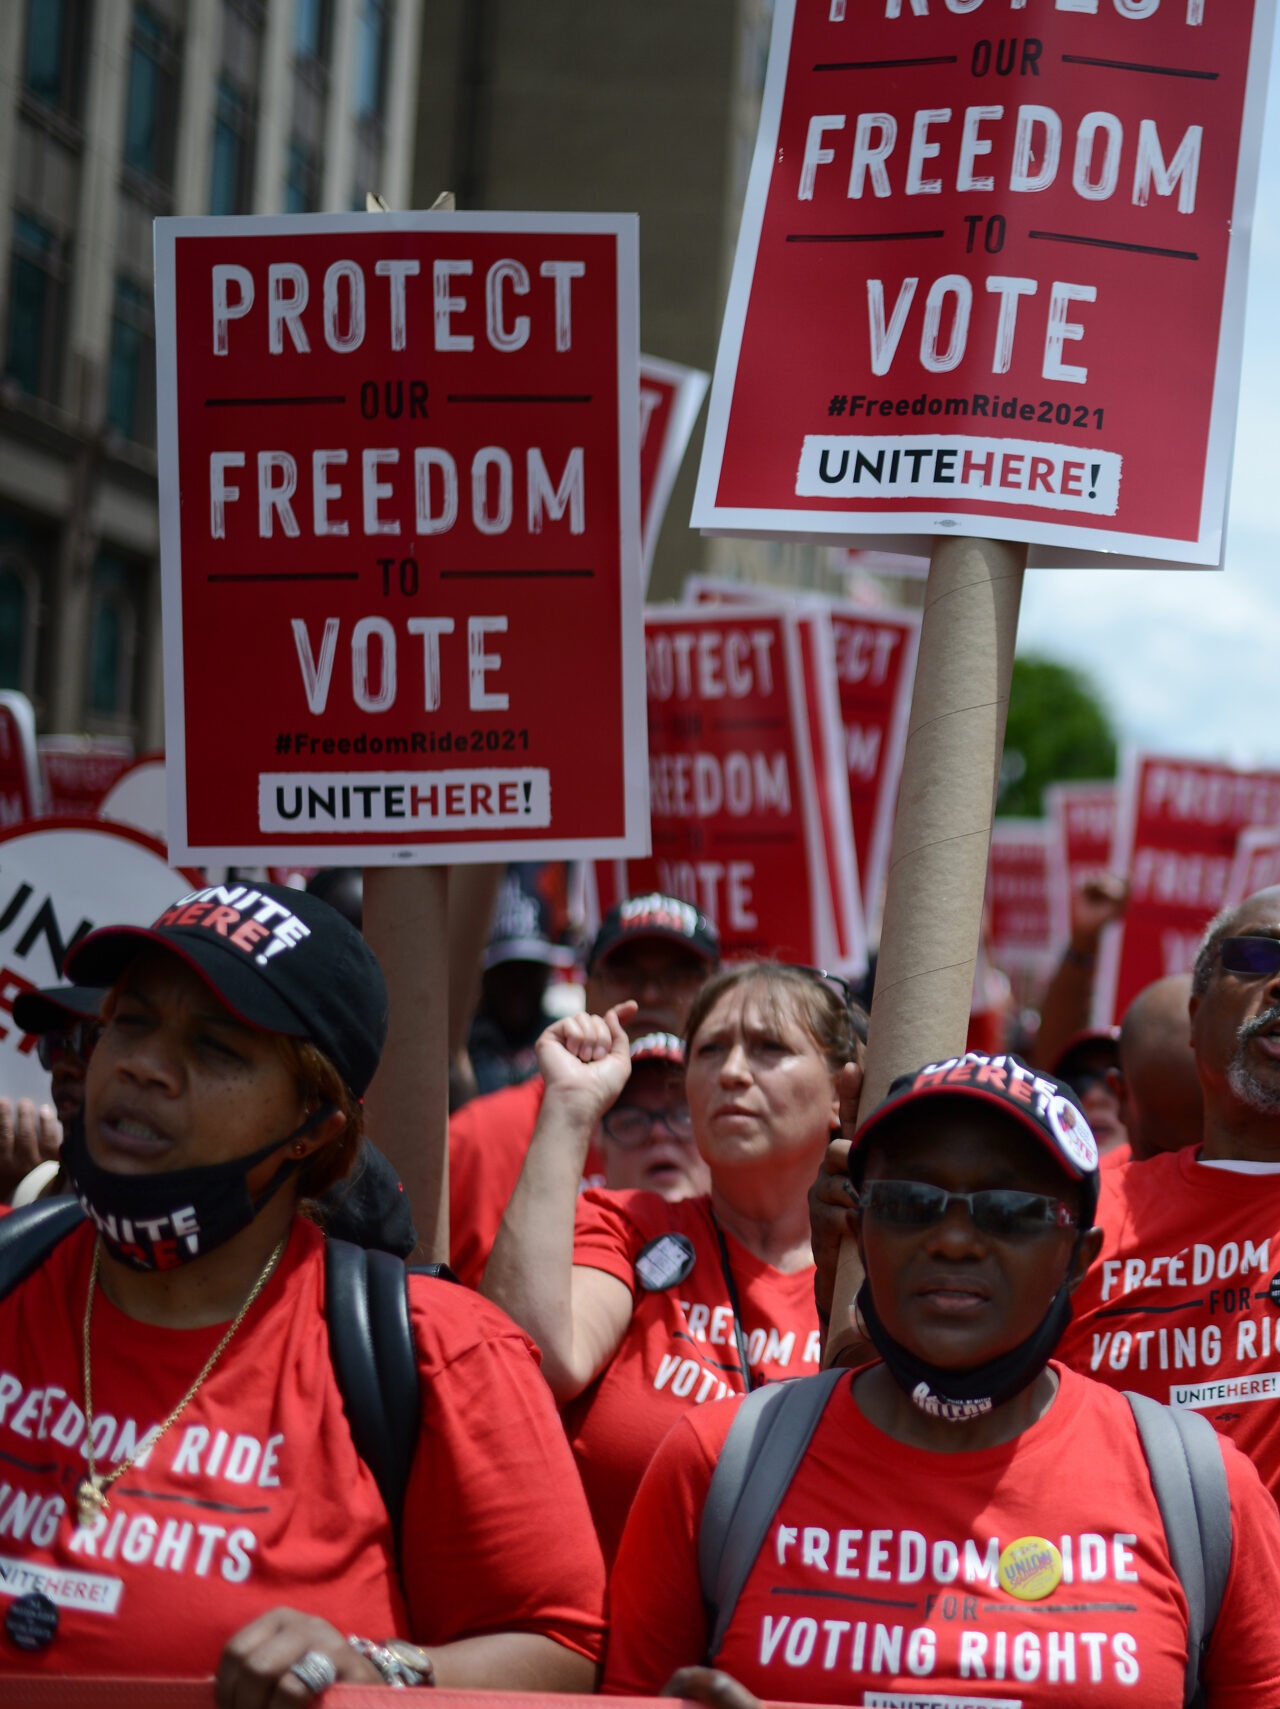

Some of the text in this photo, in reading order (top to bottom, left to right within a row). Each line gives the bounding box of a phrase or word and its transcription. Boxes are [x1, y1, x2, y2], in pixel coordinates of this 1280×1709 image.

[971, 38, 1043, 78] OUR
[797, 104, 1204, 214] FREEDOM
[963, 214, 1008, 254] TO
[211, 258, 586, 356] PROTECT
[866, 274, 1098, 384] VOTE
[360, 380, 431, 420] OUR
[827, 394, 1106, 430] #FreedomRide2021
[209, 446, 586, 540] FREEDOM
[818, 448, 1102, 500] UNITEHERE!
[376, 557, 420, 598] TO
[291, 615, 510, 716] VOTE
[275, 729, 532, 755] #FreedomRide2021
[275, 780, 533, 821] UNITEHERE!
[153, 901, 290, 965] HERE!
[174, 884, 312, 948] UNITE
[1101, 1238, 1272, 1302] FREEDOM
[1209, 1287, 1251, 1315] FOR
[680, 1301, 796, 1367] REOM
[1090, 1324, 1222, 1372] VOTING
[1176, 1378, 1277, 1405] UNITEHERE!
[171, 1425, 285, 1488] RIDE
[69, 1511, 257, 1584] RIGHTS
[777, 1524, 1000, 1588] FREEDOM
[1060, 1532, 1138, 1582] IDE
[924, 1594, 979, 1621] FOR
[759, 1615, 1141, 1685] VOTING RIGHTS
